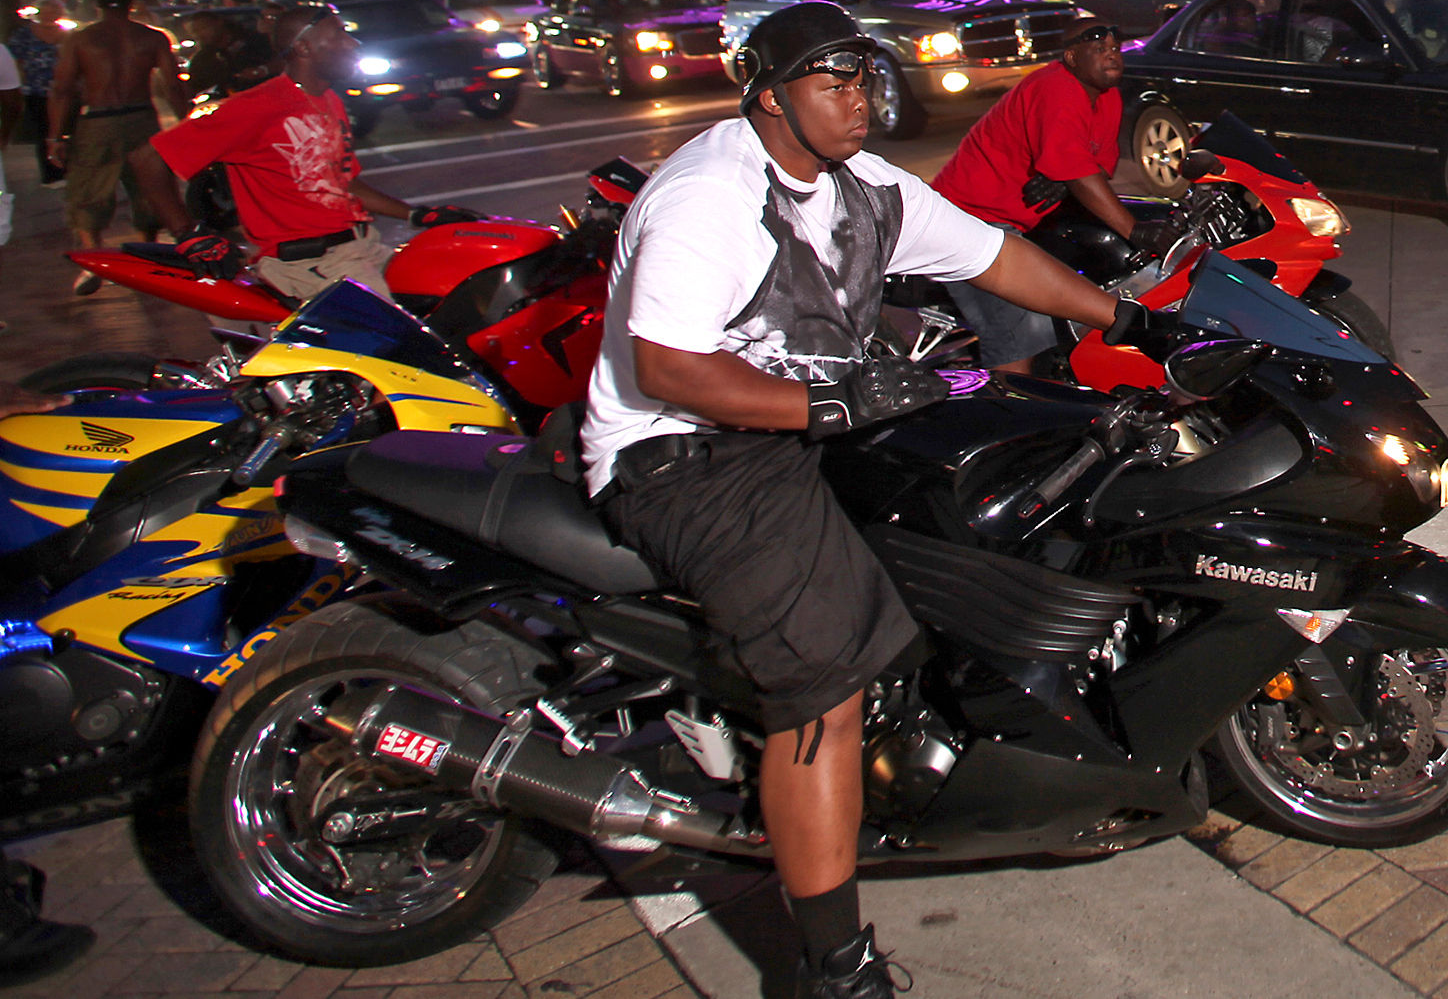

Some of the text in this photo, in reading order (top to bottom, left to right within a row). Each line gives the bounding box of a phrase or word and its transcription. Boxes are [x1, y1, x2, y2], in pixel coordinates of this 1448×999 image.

[65, 444, 130, 454] HONDA
[1195, 554, 1318, 592] Kawasaki
[107, 590, 187, 604] Racing
